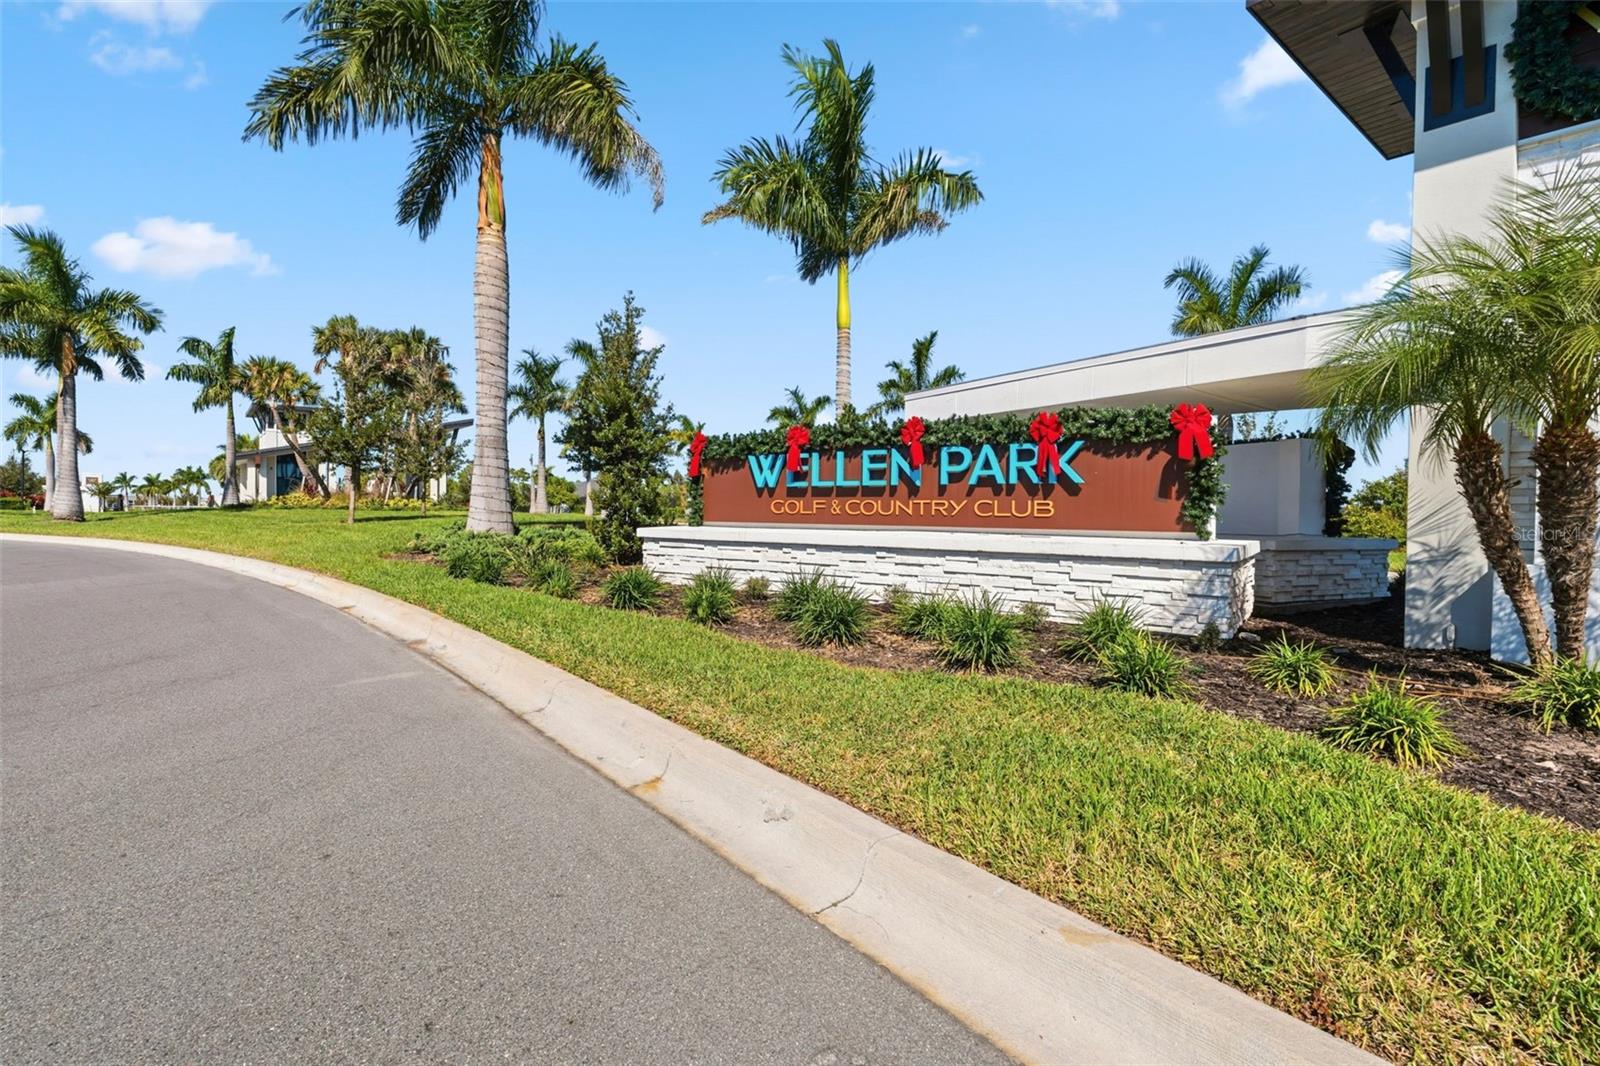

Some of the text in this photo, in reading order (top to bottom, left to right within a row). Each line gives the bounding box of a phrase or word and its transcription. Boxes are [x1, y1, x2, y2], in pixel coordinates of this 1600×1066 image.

[748, 440, 1086, 488] WELLEN PARK
[770, 499, 1055, 517] GOLF & COUNTRY CLUB
